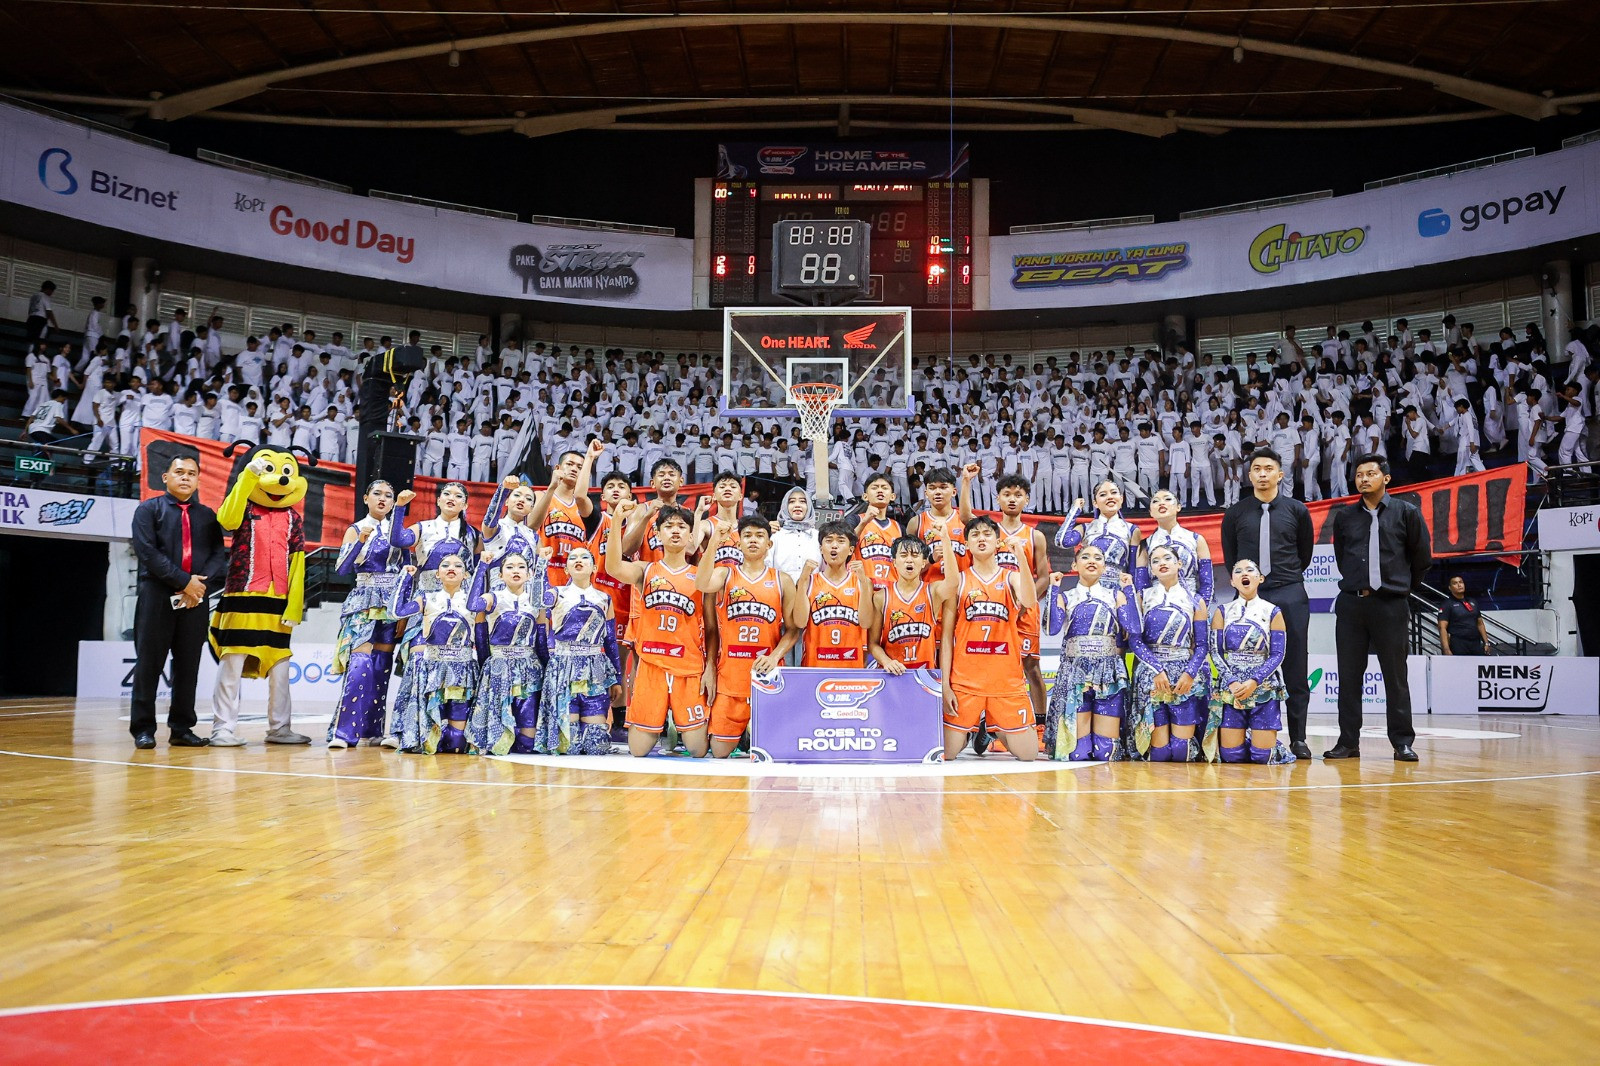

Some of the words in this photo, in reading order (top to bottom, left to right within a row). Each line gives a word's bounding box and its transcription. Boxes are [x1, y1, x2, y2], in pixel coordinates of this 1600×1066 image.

[815, 151, 872, 160] HOME
[815, 161, 926, 172] DREAMERS
[90, 169, 178, 211] Biznet
[1460, 185, 1567, 232] gopay
[269, 205, 350, 247] Good
[356, 220, 416, 264] Day
[515, 254, 536, 267] PAKE
[538, 249, 646, 274] STREET
[1014, 256, 1051, 267] YANG
[1054, 252, 1103, 265] WORTH
[1126, 248, 1143, 258] YA
[1146, 244, 1185, 257] CUMA
[539, 276, 561, 289] GAYA
[564, 276, 593, 289] MAKIN
[760, 336, 786, 348] One
[788, 336, 831, 348] HEART.
[20, 459, 52, 472] EXIT
[0, 508, 25, 524] LK
[544, 522, 585, 542] SIXER
[557, 542, 572, 556] 14
[714, 546, 744, 563] SIXER
[861, 544, 892, 558] SIXE
[874, 564, 890, 578] 27
[1302, 566, 1330, 578] pital
[645, 590, 695, 616] SIXERS
[966, 601, 1009, 622] SXERS
[728, 602, 777, 624] SIXERS
[812, 606, 859, 626] SIXERS
[658, 614, 677, 632] 19
[738, 626, 760, 643] 22
[831, 629, 841, 645] 9
[982, 625, 992, 642] 7
[1022, 638, 1031, 651] 8
[904, 645, 917, 662] 11
[1478, 680, 1540, 700] Bioré
[686, 704, 704, 722] 19
[1018, 708, 1028, 724] 7
[813, 728, 856, 738] GOES
[860, 728, 882, 738] TO
[798, 738, 876, 752] ROUND
[883, 738, 898, 752] 2
